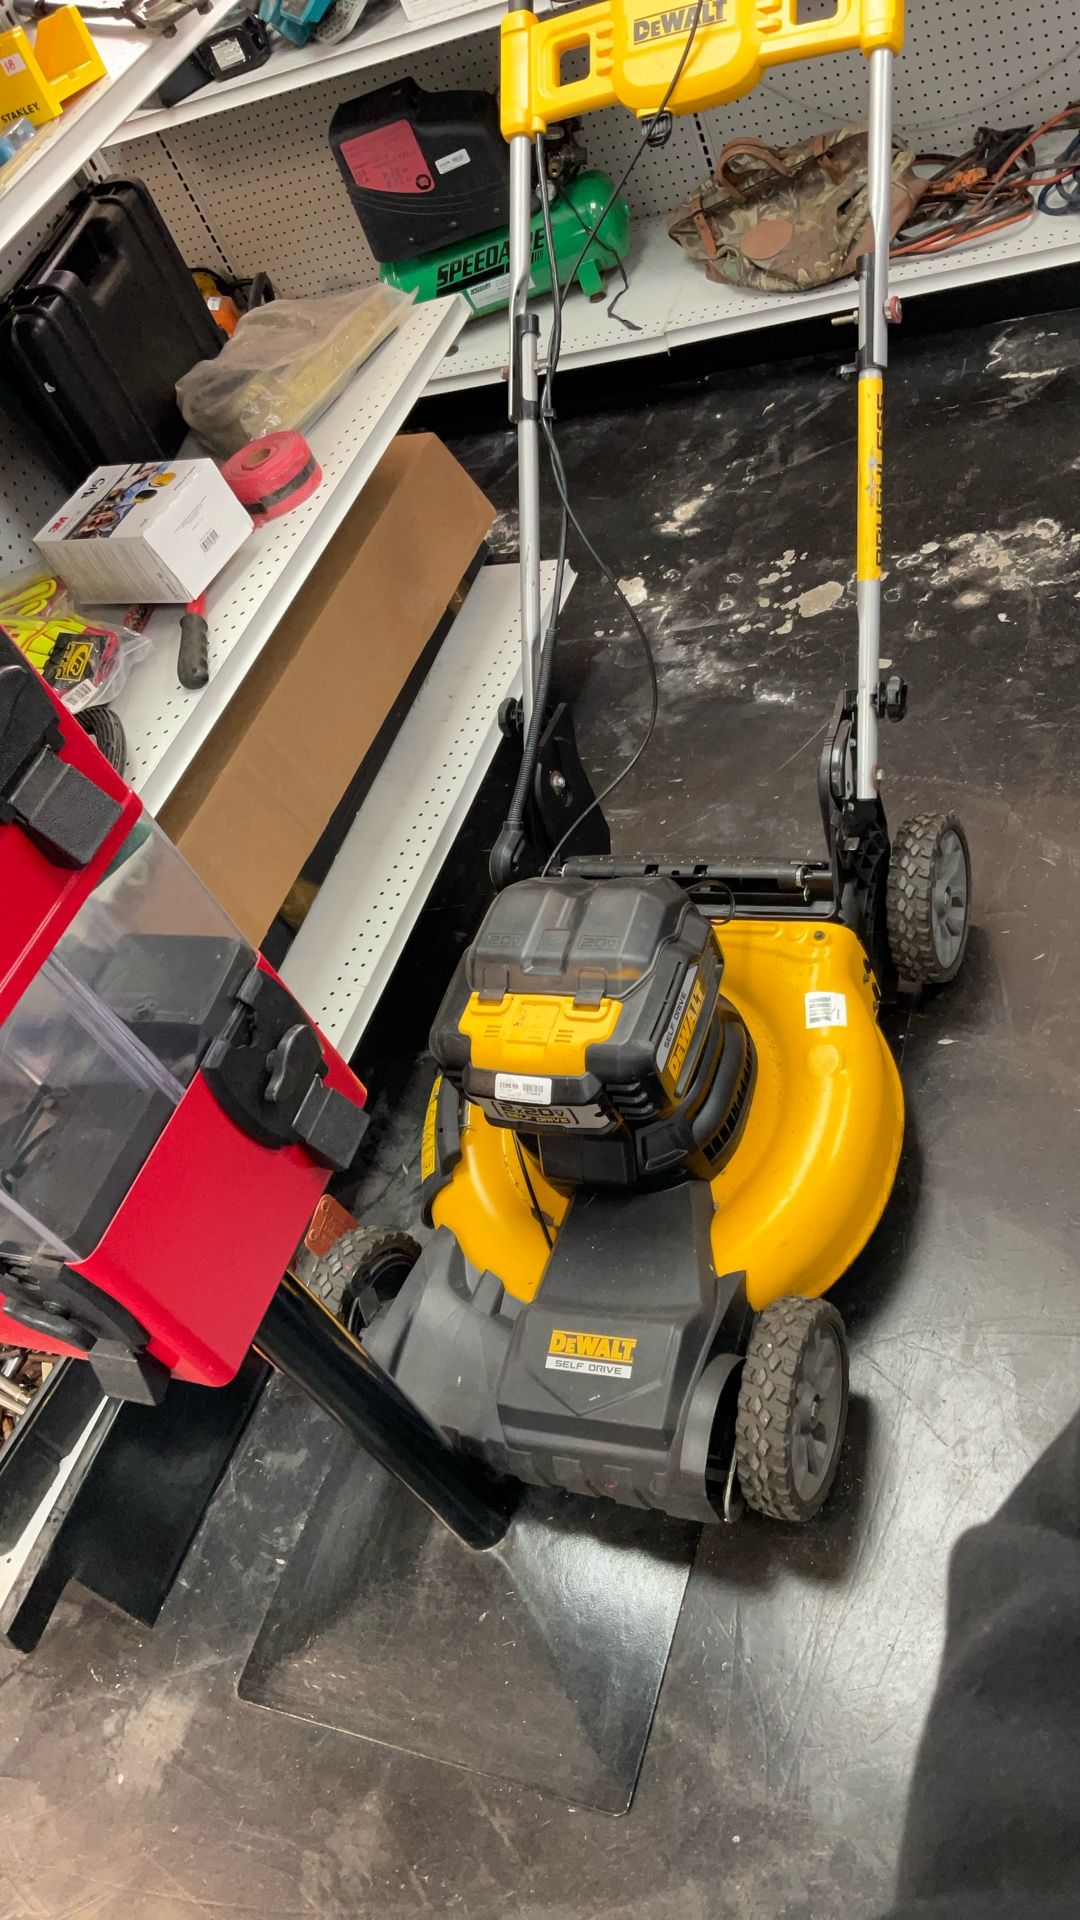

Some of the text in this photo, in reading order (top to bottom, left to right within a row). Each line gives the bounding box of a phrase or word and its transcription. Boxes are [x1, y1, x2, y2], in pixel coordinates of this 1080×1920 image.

[0, 102, 40, 123] STANLEY
[663, 991, 688, 1049] SELF DRIVE
[668, 979, 706, 1081] DEWALT
[550, 1332, 637, 1361] DEWALT
[555, 1359, 622, 1375] SELF DRIVE
